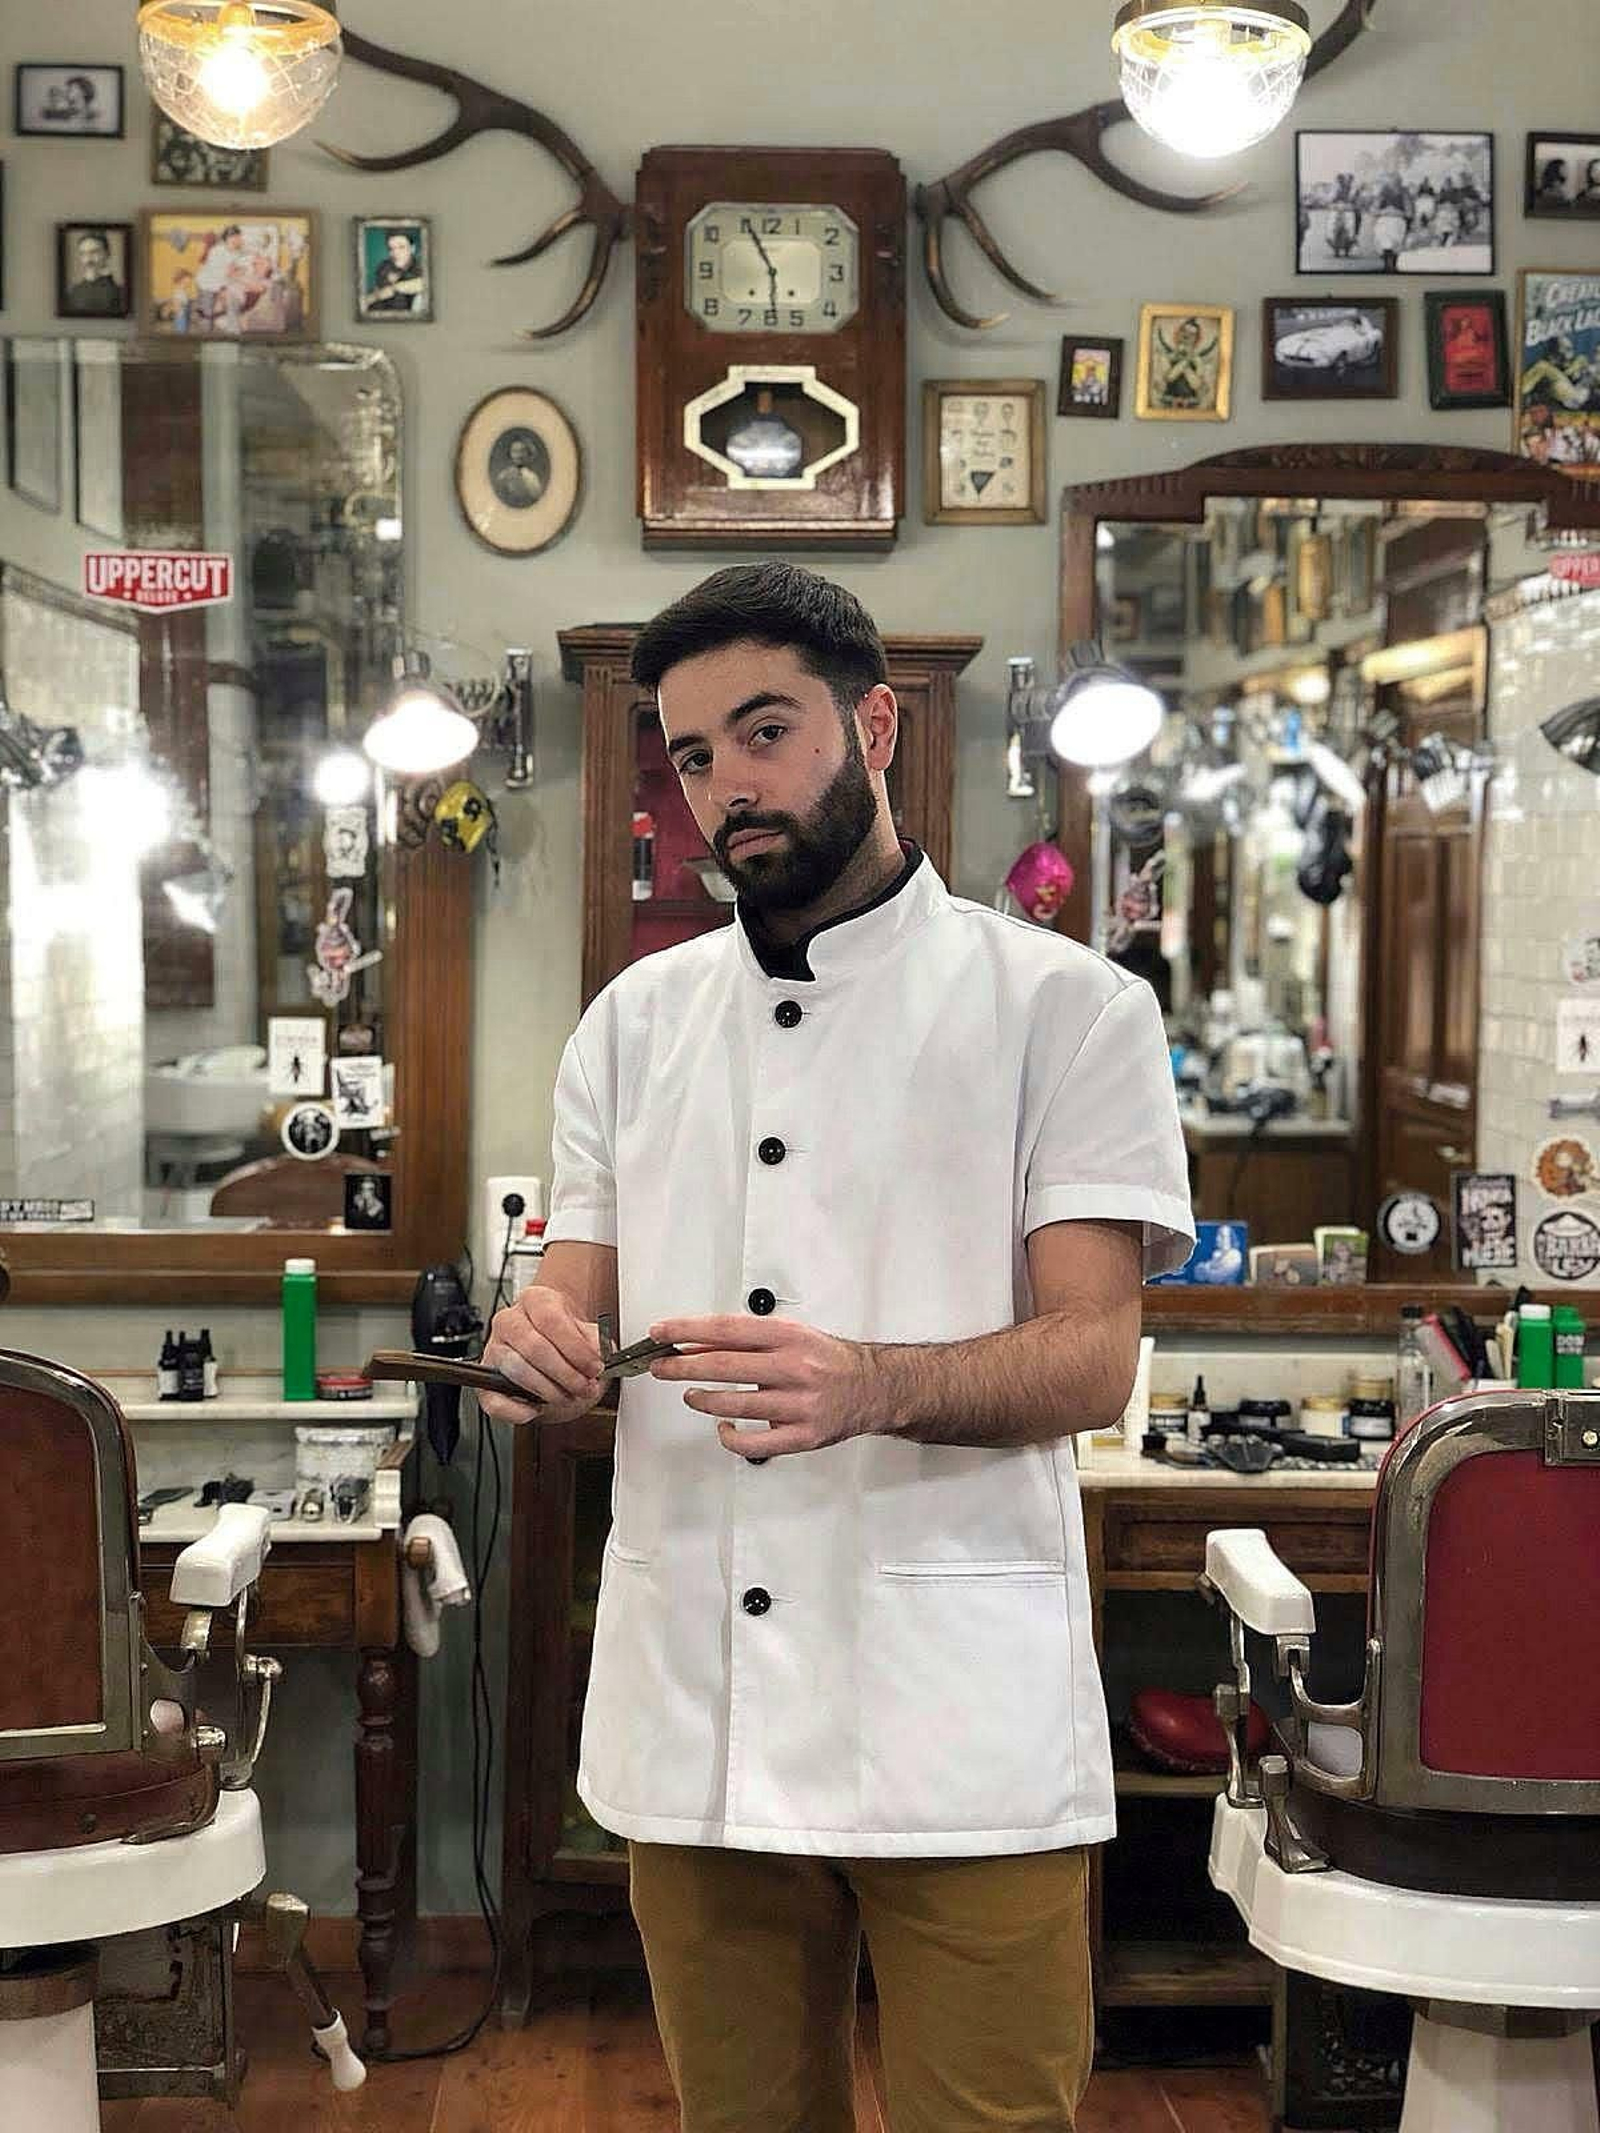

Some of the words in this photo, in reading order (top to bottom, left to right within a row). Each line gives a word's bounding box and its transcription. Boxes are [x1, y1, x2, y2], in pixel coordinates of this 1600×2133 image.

[704, 226, 719, 243] 10
[762, 219, 781, 234] 12
[824, 228, 839, 245] 2
[699, 261, 713, 279] 9
[829, 264, 843, 281] 3
[704, 298, 718, 316] 8
[822, 301, 838, 318] 4
[738, 310, 752, 325] 7
[763, 310, 778, 326] 6
[790, 310, 804, 326] 5
[88, 556, 227, 597] UPPERCUT
